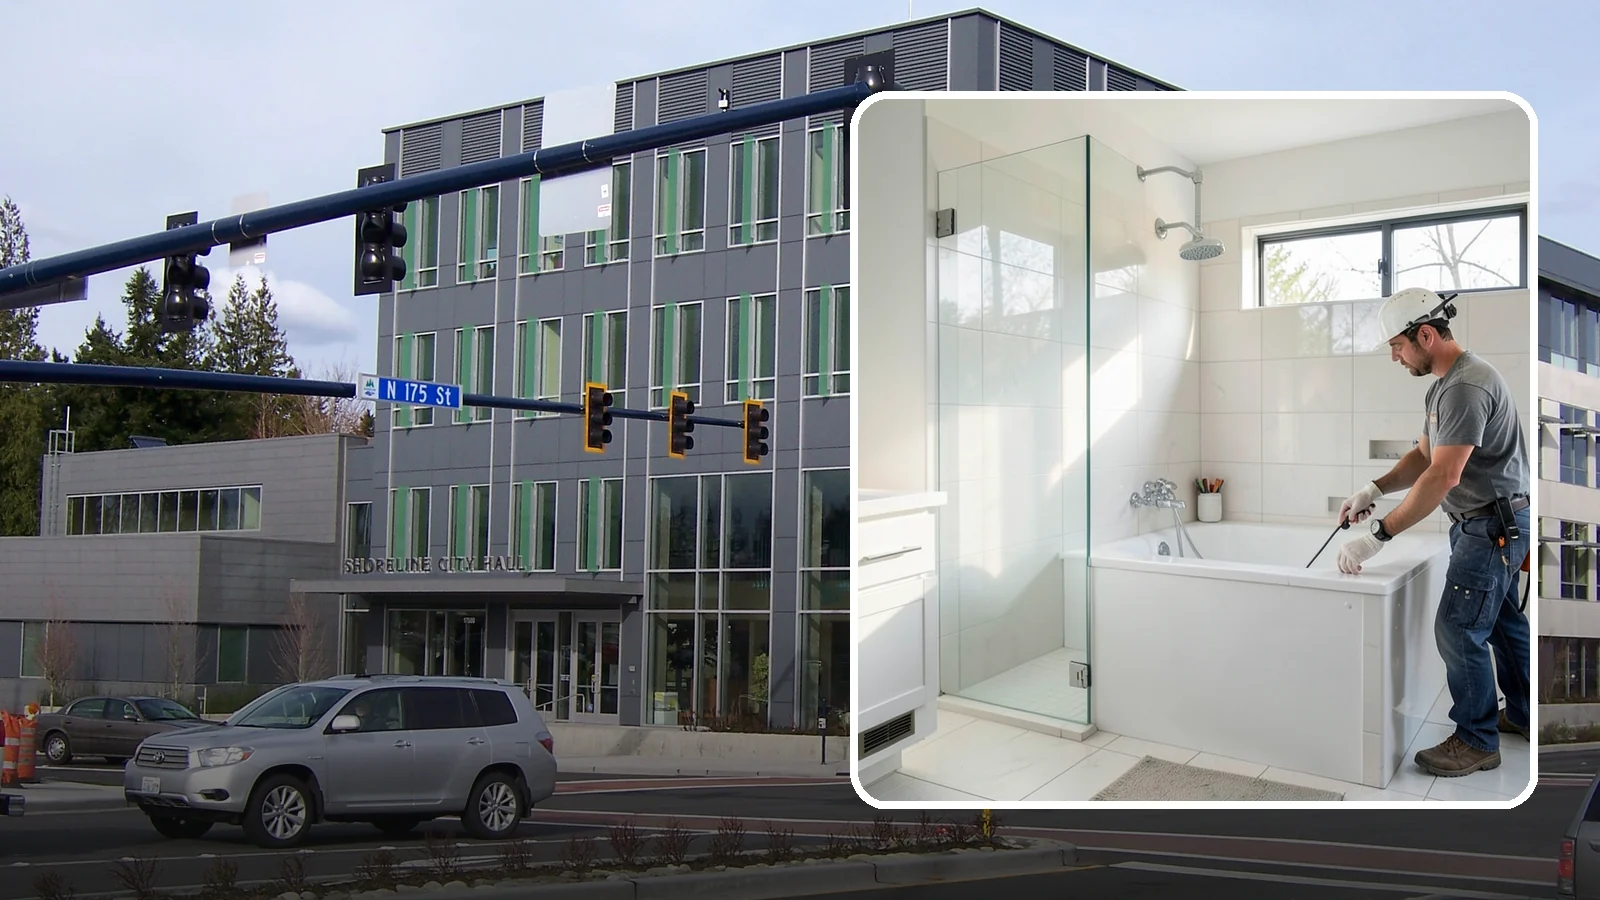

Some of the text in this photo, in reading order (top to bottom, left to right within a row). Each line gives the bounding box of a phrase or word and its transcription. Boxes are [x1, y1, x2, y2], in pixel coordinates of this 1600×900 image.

[387, 380, 451, 406] N 175 St
[344, 555, 525, 574] SHORELINE CITY HALL
